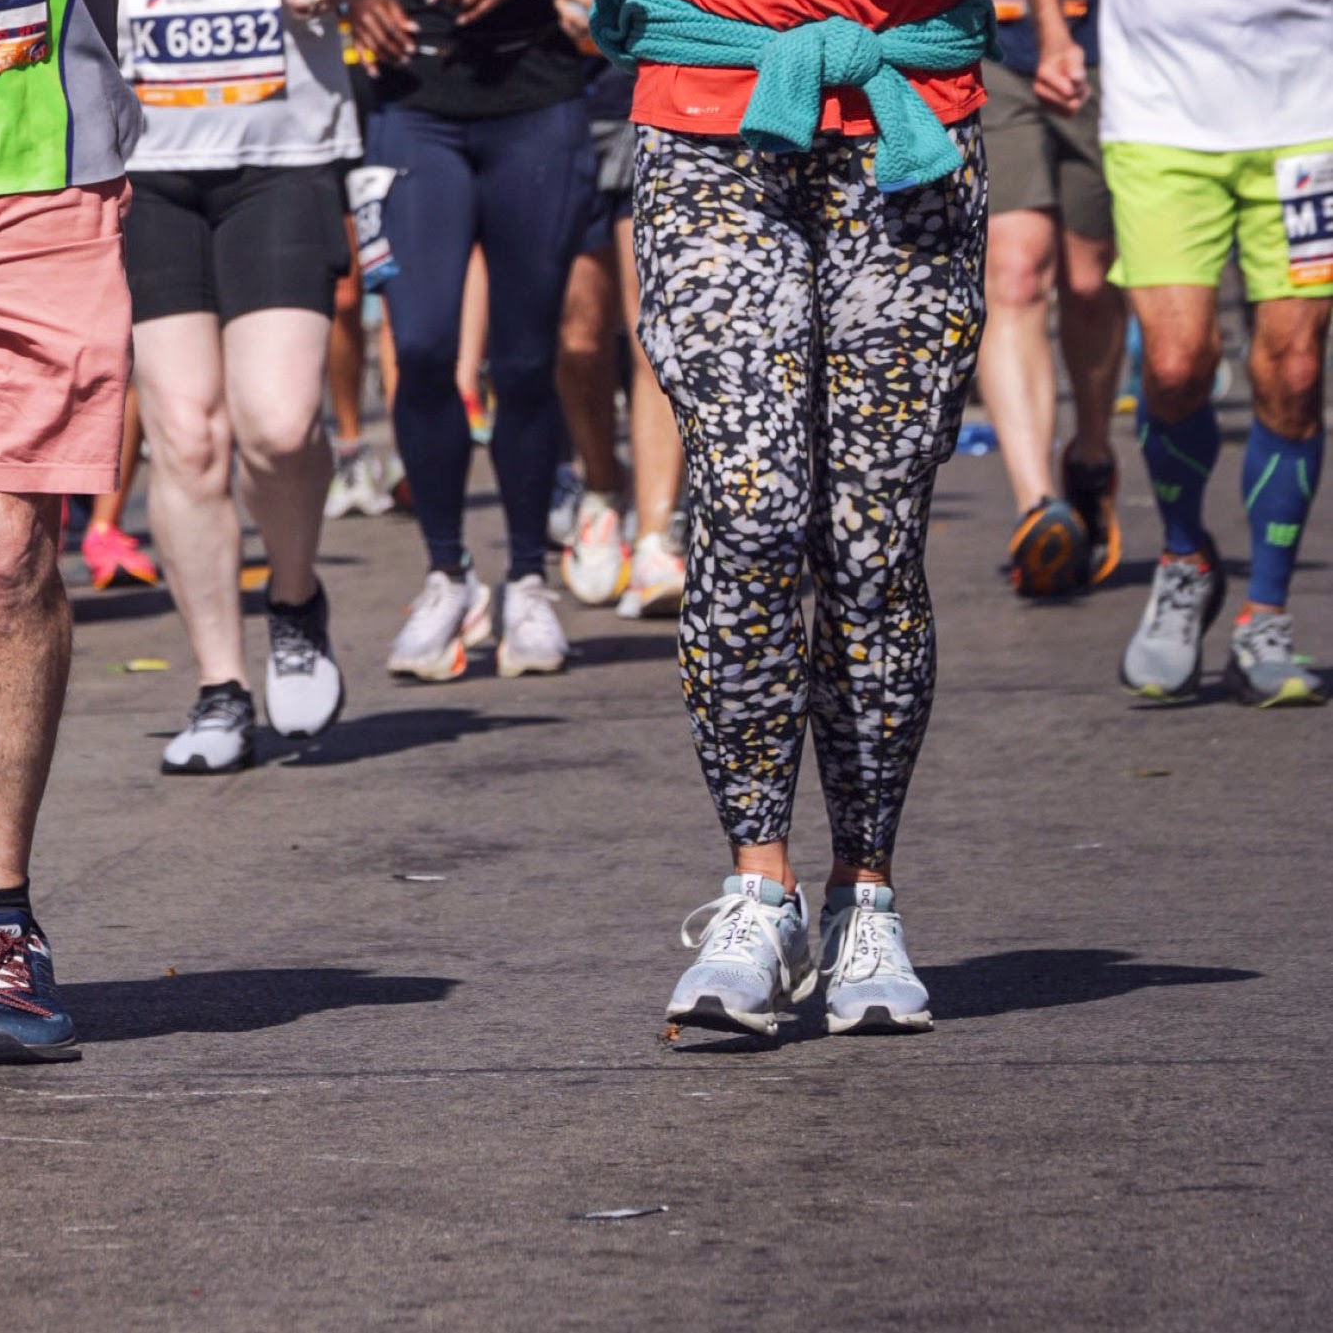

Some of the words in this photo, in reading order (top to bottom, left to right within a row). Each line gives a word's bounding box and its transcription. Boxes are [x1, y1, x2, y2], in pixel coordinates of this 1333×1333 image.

[132, 19, 160, 58] K
[166, 11, 282, 58] 68332
[1284, 200, 1318, 239] M
